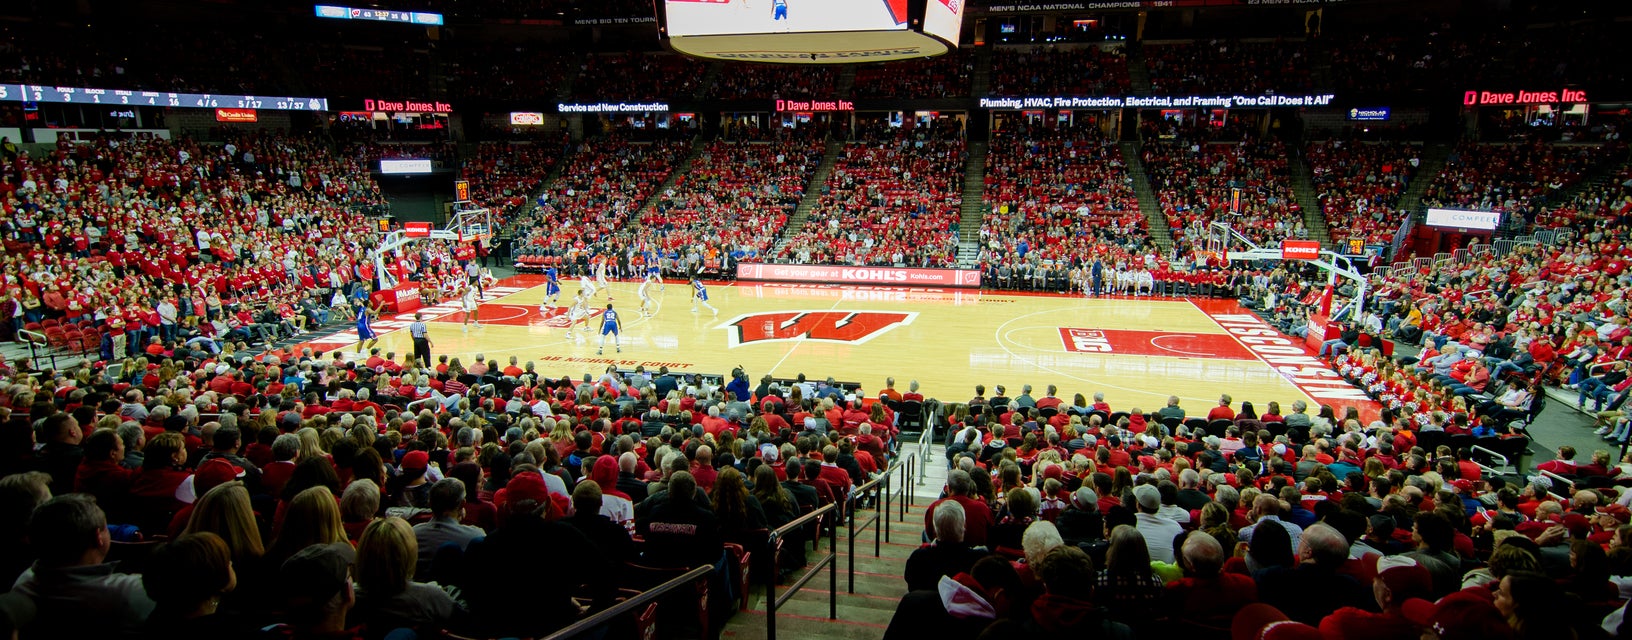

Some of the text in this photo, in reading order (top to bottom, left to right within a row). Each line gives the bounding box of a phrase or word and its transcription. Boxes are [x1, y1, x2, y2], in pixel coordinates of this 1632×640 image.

[35, 91, 42, 101] 3
[64, 93, 71, 102] 3
[93, 94, 100, 103] 1
[122, 95, 128, 104] 3
[149, 97, 155, 105] 4
[169, 98, 179, 106] 16
[980, 97, 1022, 108] Plumbing,
[1024, 97, 1052, 107] HVAC,
[1054, 97, 1070, 106] Fire
[1126, 96, 1172, 106] Electrical,
[1173, 96, 1192, 105] and
[1193, 96, 1231, 107] Framing
[1257, 95, 1277, 105] Call
[1278, 95, 1303, 104] Does
[1305, 95, 1313, 104] It
[1480, 91, 1513, 105] Dave
[1561, 89, 1587, 103] Inc.
[378, 99, 403, 111] Dave
[436, 101, 453, 112] Inc.
[558, 102, 669, 112] Service and New Construction
[787, 100, 809, 111] Dave
[839, 99, 855, 111] Inc.
[774, 268, 788, 277] Get
[791, 268, 808, 279] your
[810, 270, 828, 280] gear
[830, 270, 839, 278] at
[842, 269, 907, 281] KOHL'S
[910, 273, 943, 281] Kohls.com
[606, 312, 615, 320] 22
[564, 357, 637, 366] NICHOLAS
[640, 360, 694, 368] COURT
[1210, 313, 1372, 401] WISCONSIN
